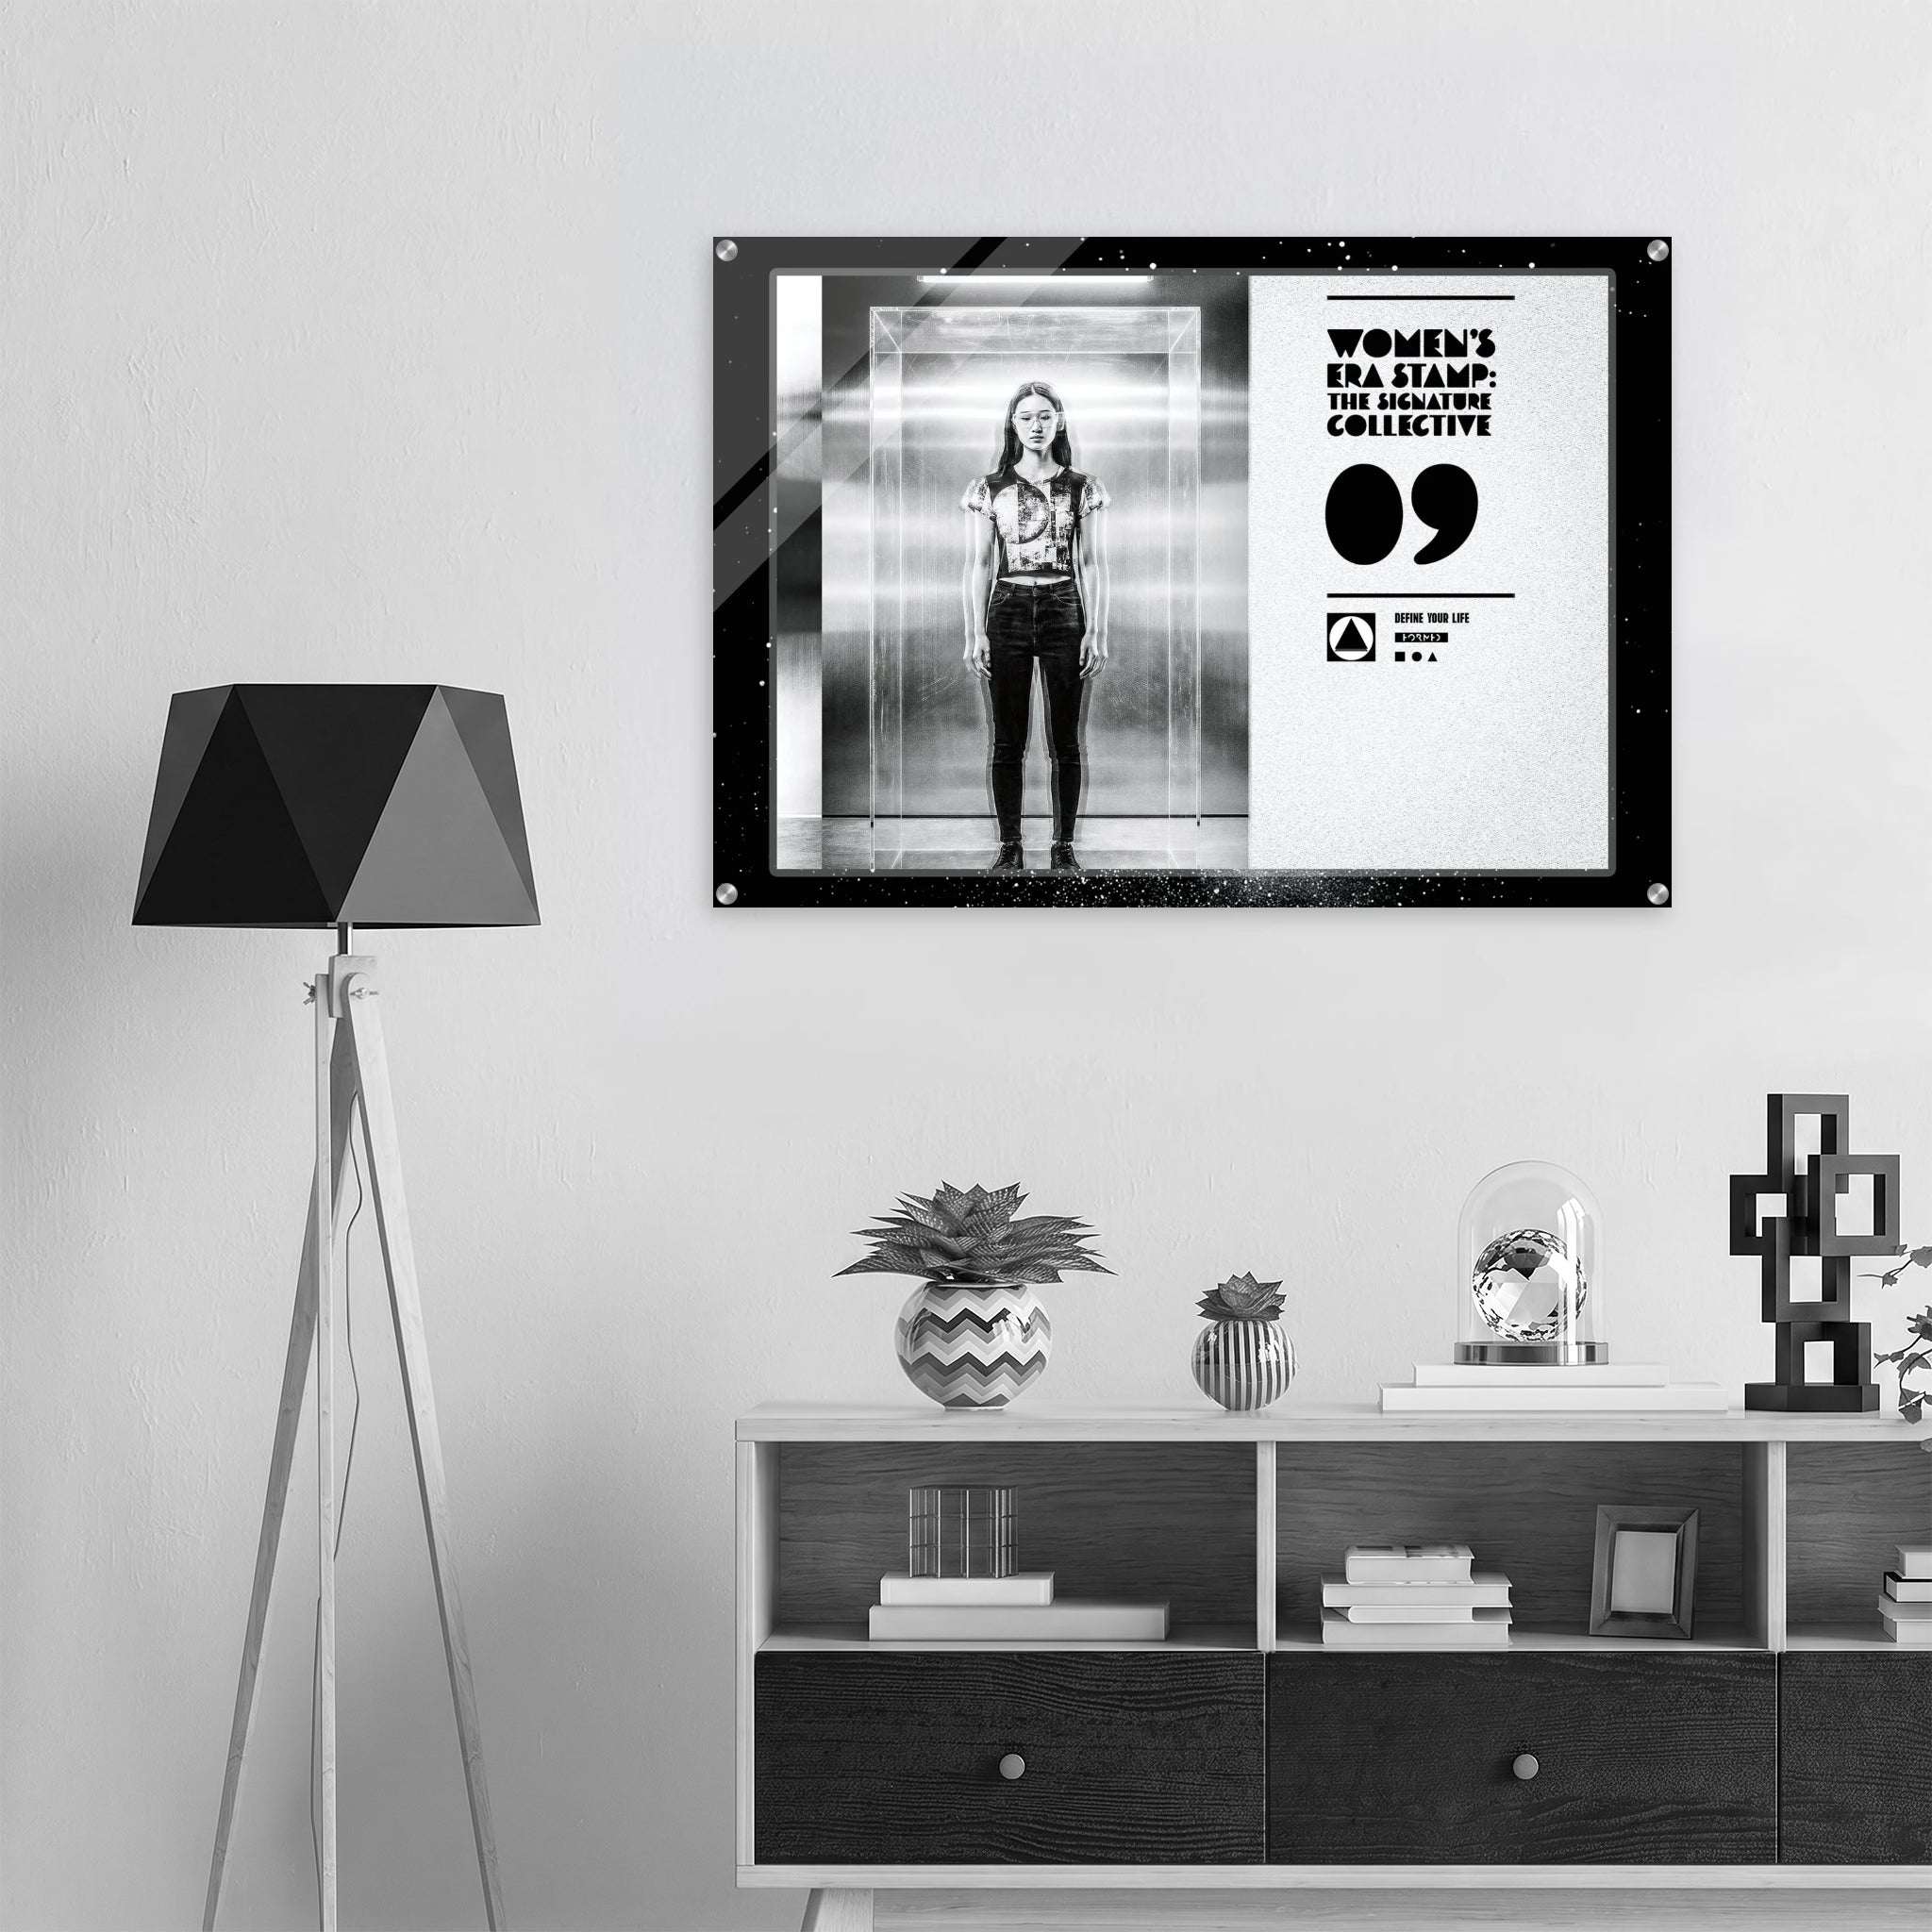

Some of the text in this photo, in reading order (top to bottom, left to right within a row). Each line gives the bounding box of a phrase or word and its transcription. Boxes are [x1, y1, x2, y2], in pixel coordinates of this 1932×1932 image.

[1327, 328, 1496, 358] WOMEN'S
[1327, 363, 1497, 388] ERA STAMP:
[1327, 392, 1491, 410] THE SIGNATURE
[1327, 414, 1491, 437] COLLECTIVE
[1394, 612, 1470, 624] DEFINE YOUR LIFE
